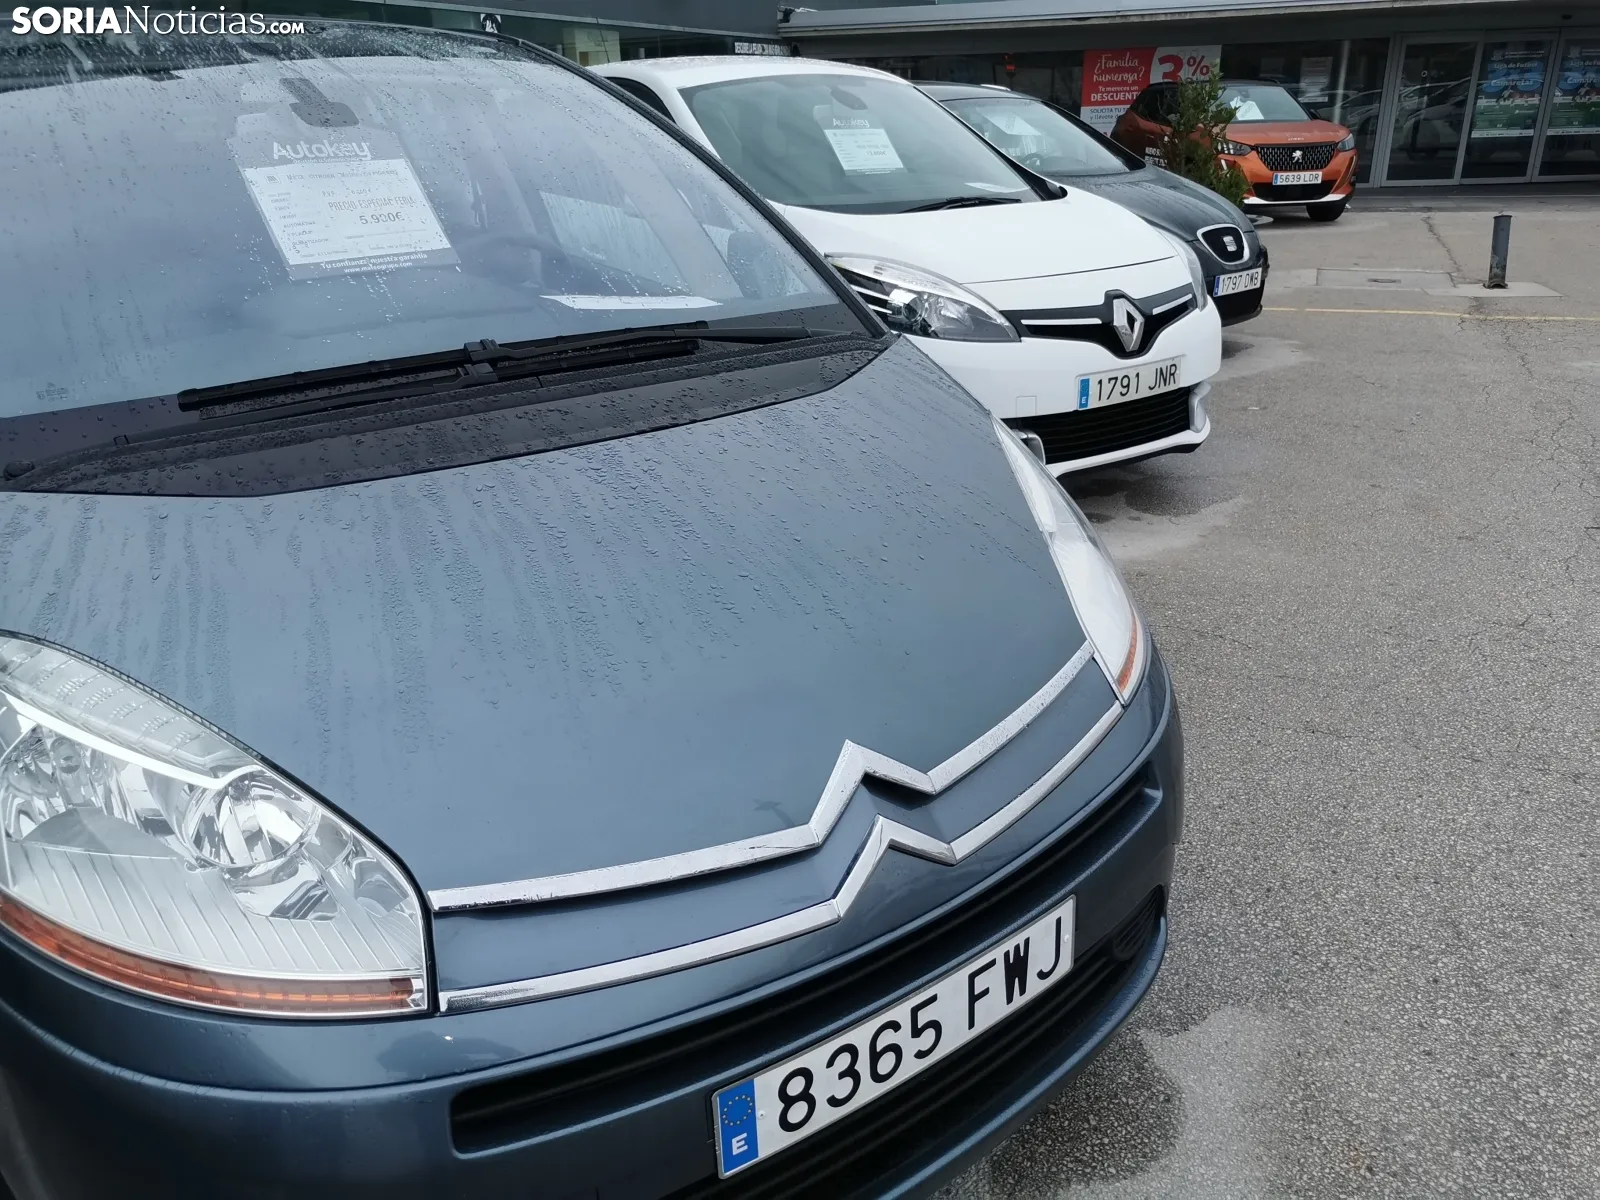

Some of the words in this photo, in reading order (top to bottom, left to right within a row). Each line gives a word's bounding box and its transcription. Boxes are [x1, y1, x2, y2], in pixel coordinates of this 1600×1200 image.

[1094, 51, 1139, 74] ¿Familia
[1093, 66, 1145, 84] numerosa?
[1091, 91, 1140, 102] DESCUENT
[273, 139, 372, 161] Autokey
[1279, 173, 1301, 183] 5639
[1303, 172, 1320, 183] LDR
[328, 200, 357, 212] PRECIO
[320, 262, 331, 270] Tu
[1096, 372, 1140, 402] 1791
[1148, 363, 1178, 391] JNR
[731, 1131, 748, 1156] E
[777, 993, 943, 1134] 8365
[967, 915, 1062, 1031] FWJ
